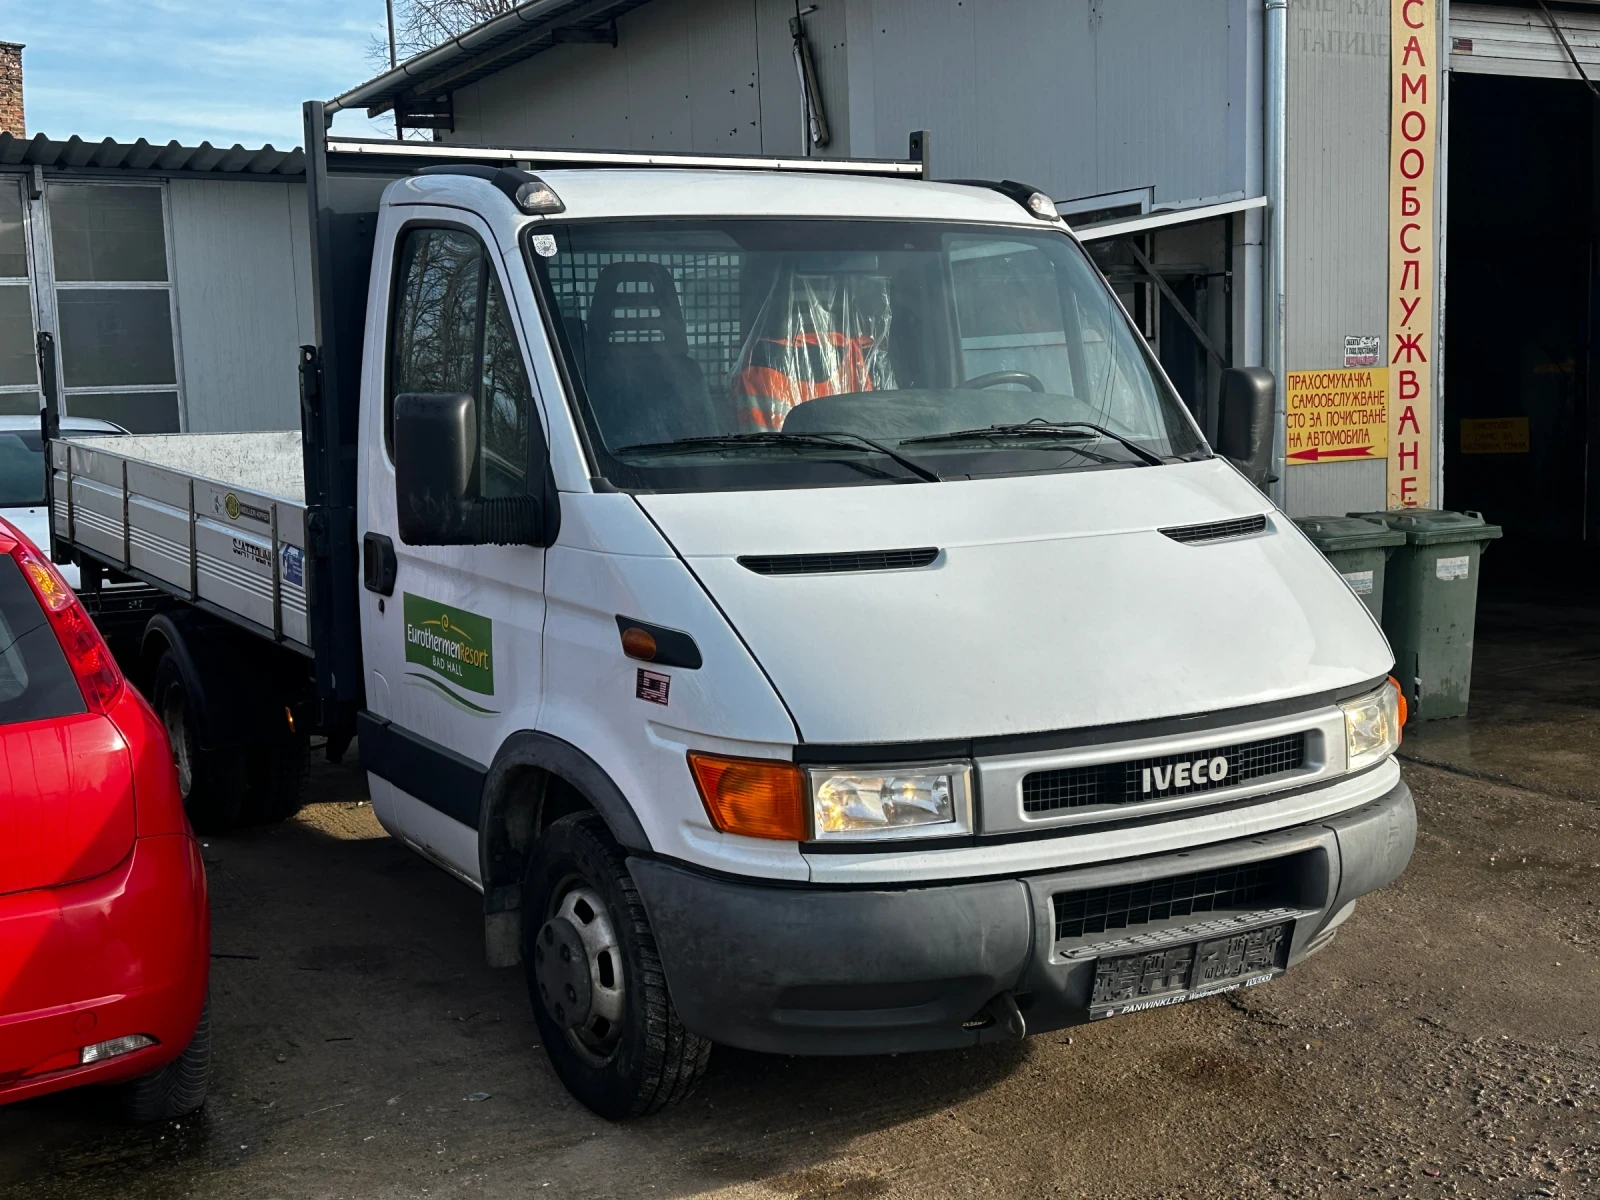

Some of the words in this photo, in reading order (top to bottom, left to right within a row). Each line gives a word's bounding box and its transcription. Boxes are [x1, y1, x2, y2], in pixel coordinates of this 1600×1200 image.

[1392, 0, 1428, 506] САМООБСЛУЖВАНЕ
[1288, 372, 1372, 391] ПРАХОСМУКАЧКА
[1292, 390, 1385, 409] САМООБСЛУЖВАНЕ
[1309, 412, 1322, 428] ЗА
[1326, 408, 1386, 427] ПОЧИСТВАНЕ
[1289, 432, 1302, 448] НА
[1306, 428, 1371, 447] АВТОМОБИЛА
[432, 655, 445, 670] BAD
[446, 660, 463, 677] HALL
[1142, 756, 1228, 793] IVECO
